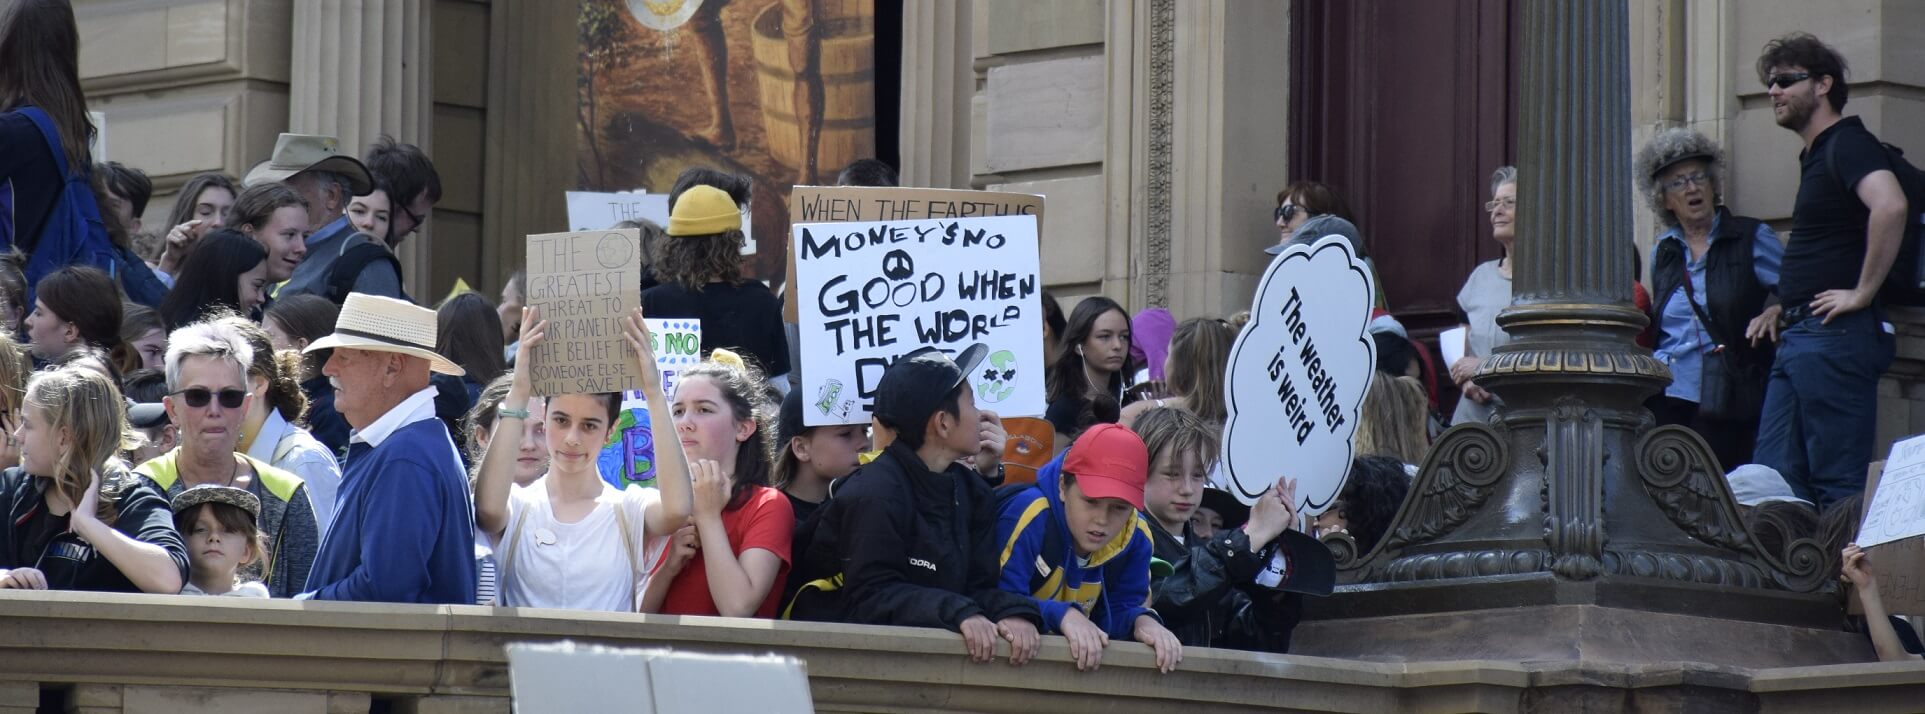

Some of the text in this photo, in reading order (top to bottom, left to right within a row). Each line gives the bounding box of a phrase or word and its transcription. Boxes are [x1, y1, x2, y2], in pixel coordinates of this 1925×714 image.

[608, 202, 640, 221] THE
[801, 194, 861, 221] WHEN
[875, 199, 920, 222] THE
[963, 228, 1006, 250] NO
[531, 236, 582, 273] THE
[530, 271, 625, 300] GREATEST
[818, 269, 1035, 317] GOOD WHEN
[530, 297, 622, 319] THREAT TO
[543, 316, 624, 341] UR PLANET IS
[824, 314, 900, 356] THE
[532, 342, 561, 364] THE
[567, 339, 612, 362] BELIEF
[665, 332, 698, 355] NO
[532, 363, 626, 382] SOMEONE ELSE
[1281, 286, 1345, 435] The weather
[532, 375, 636, 397] WILL SAVE IT
[1267, 345, 1316, 447] is weird
[622, 424, 657, 482] B
[909, 557, 937, 572] DORA
